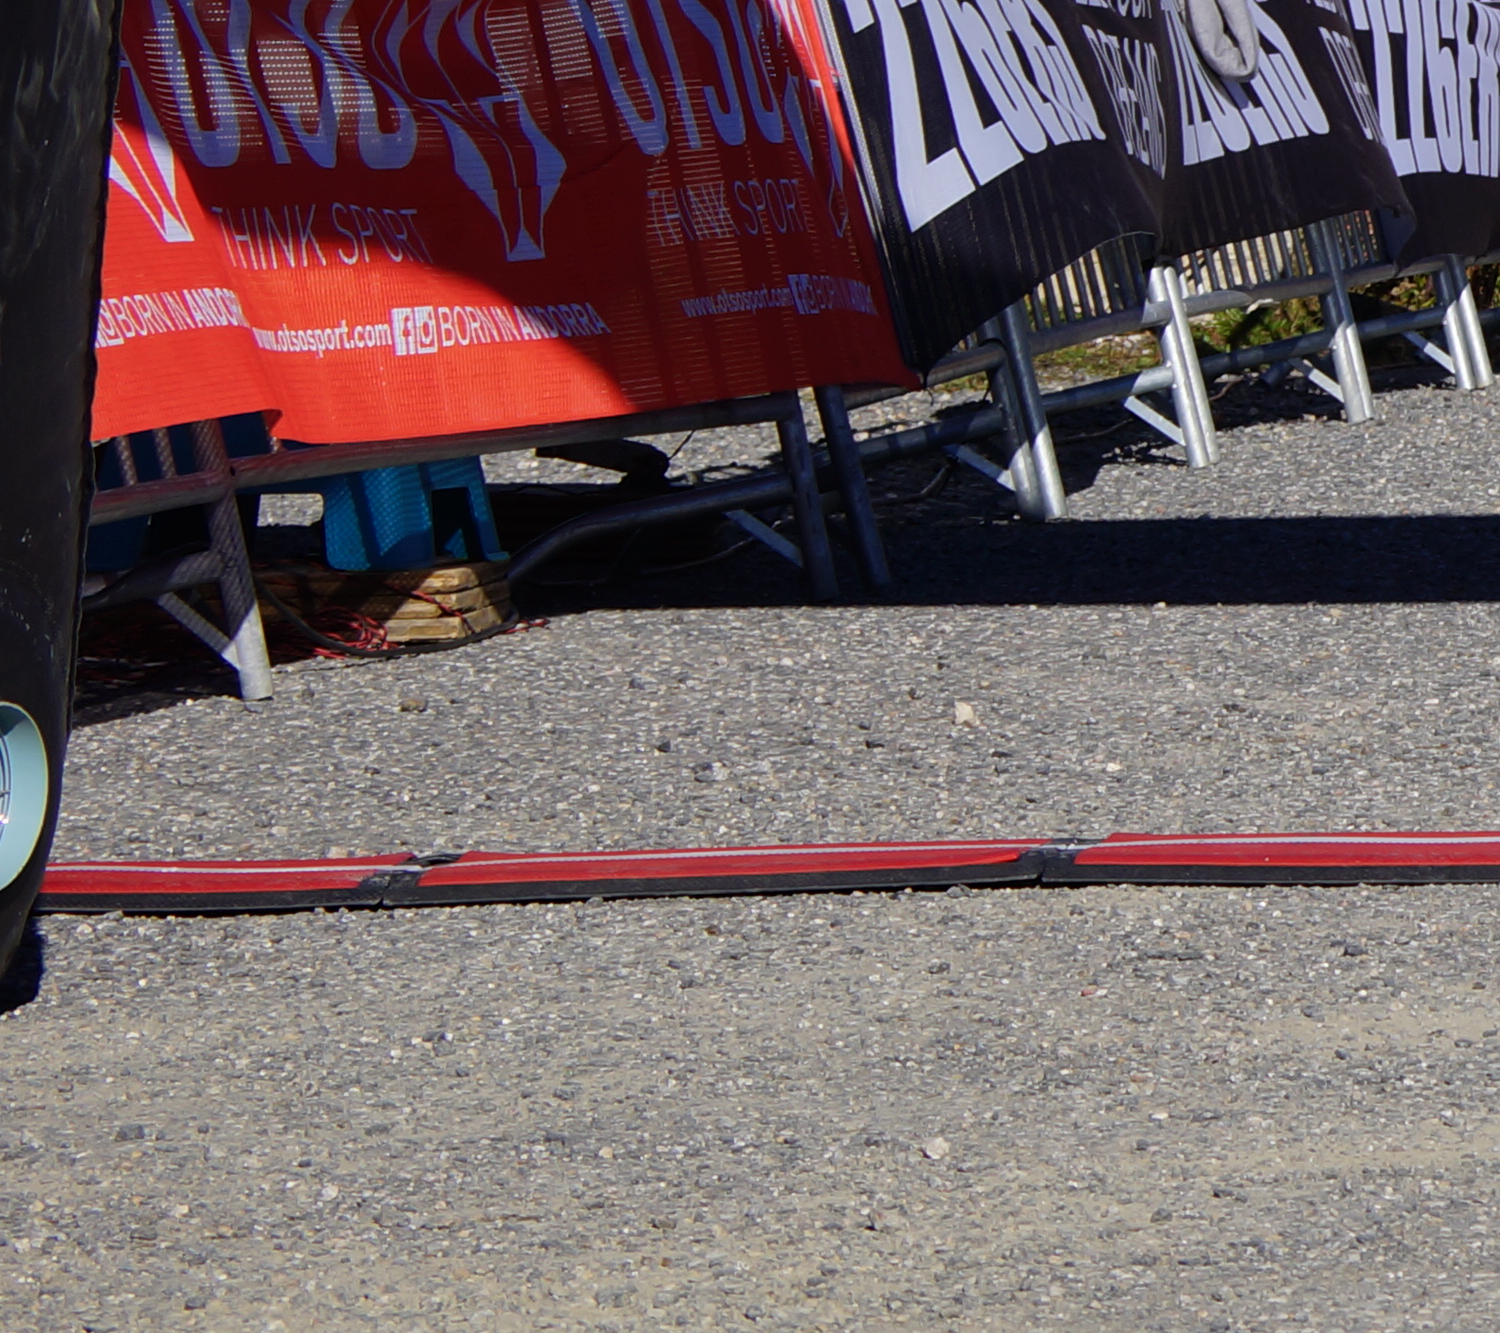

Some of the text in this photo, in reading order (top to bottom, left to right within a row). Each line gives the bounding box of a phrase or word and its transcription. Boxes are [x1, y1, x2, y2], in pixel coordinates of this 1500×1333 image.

[212, 201, 434, 270] THINK SPORT
[646, 177, 812, 247] THINK SPORT
[437, 306, 499, 348] BORN
[490, 306, 522, 342] IN
[512, 301, 612, 342] ANDORRA
